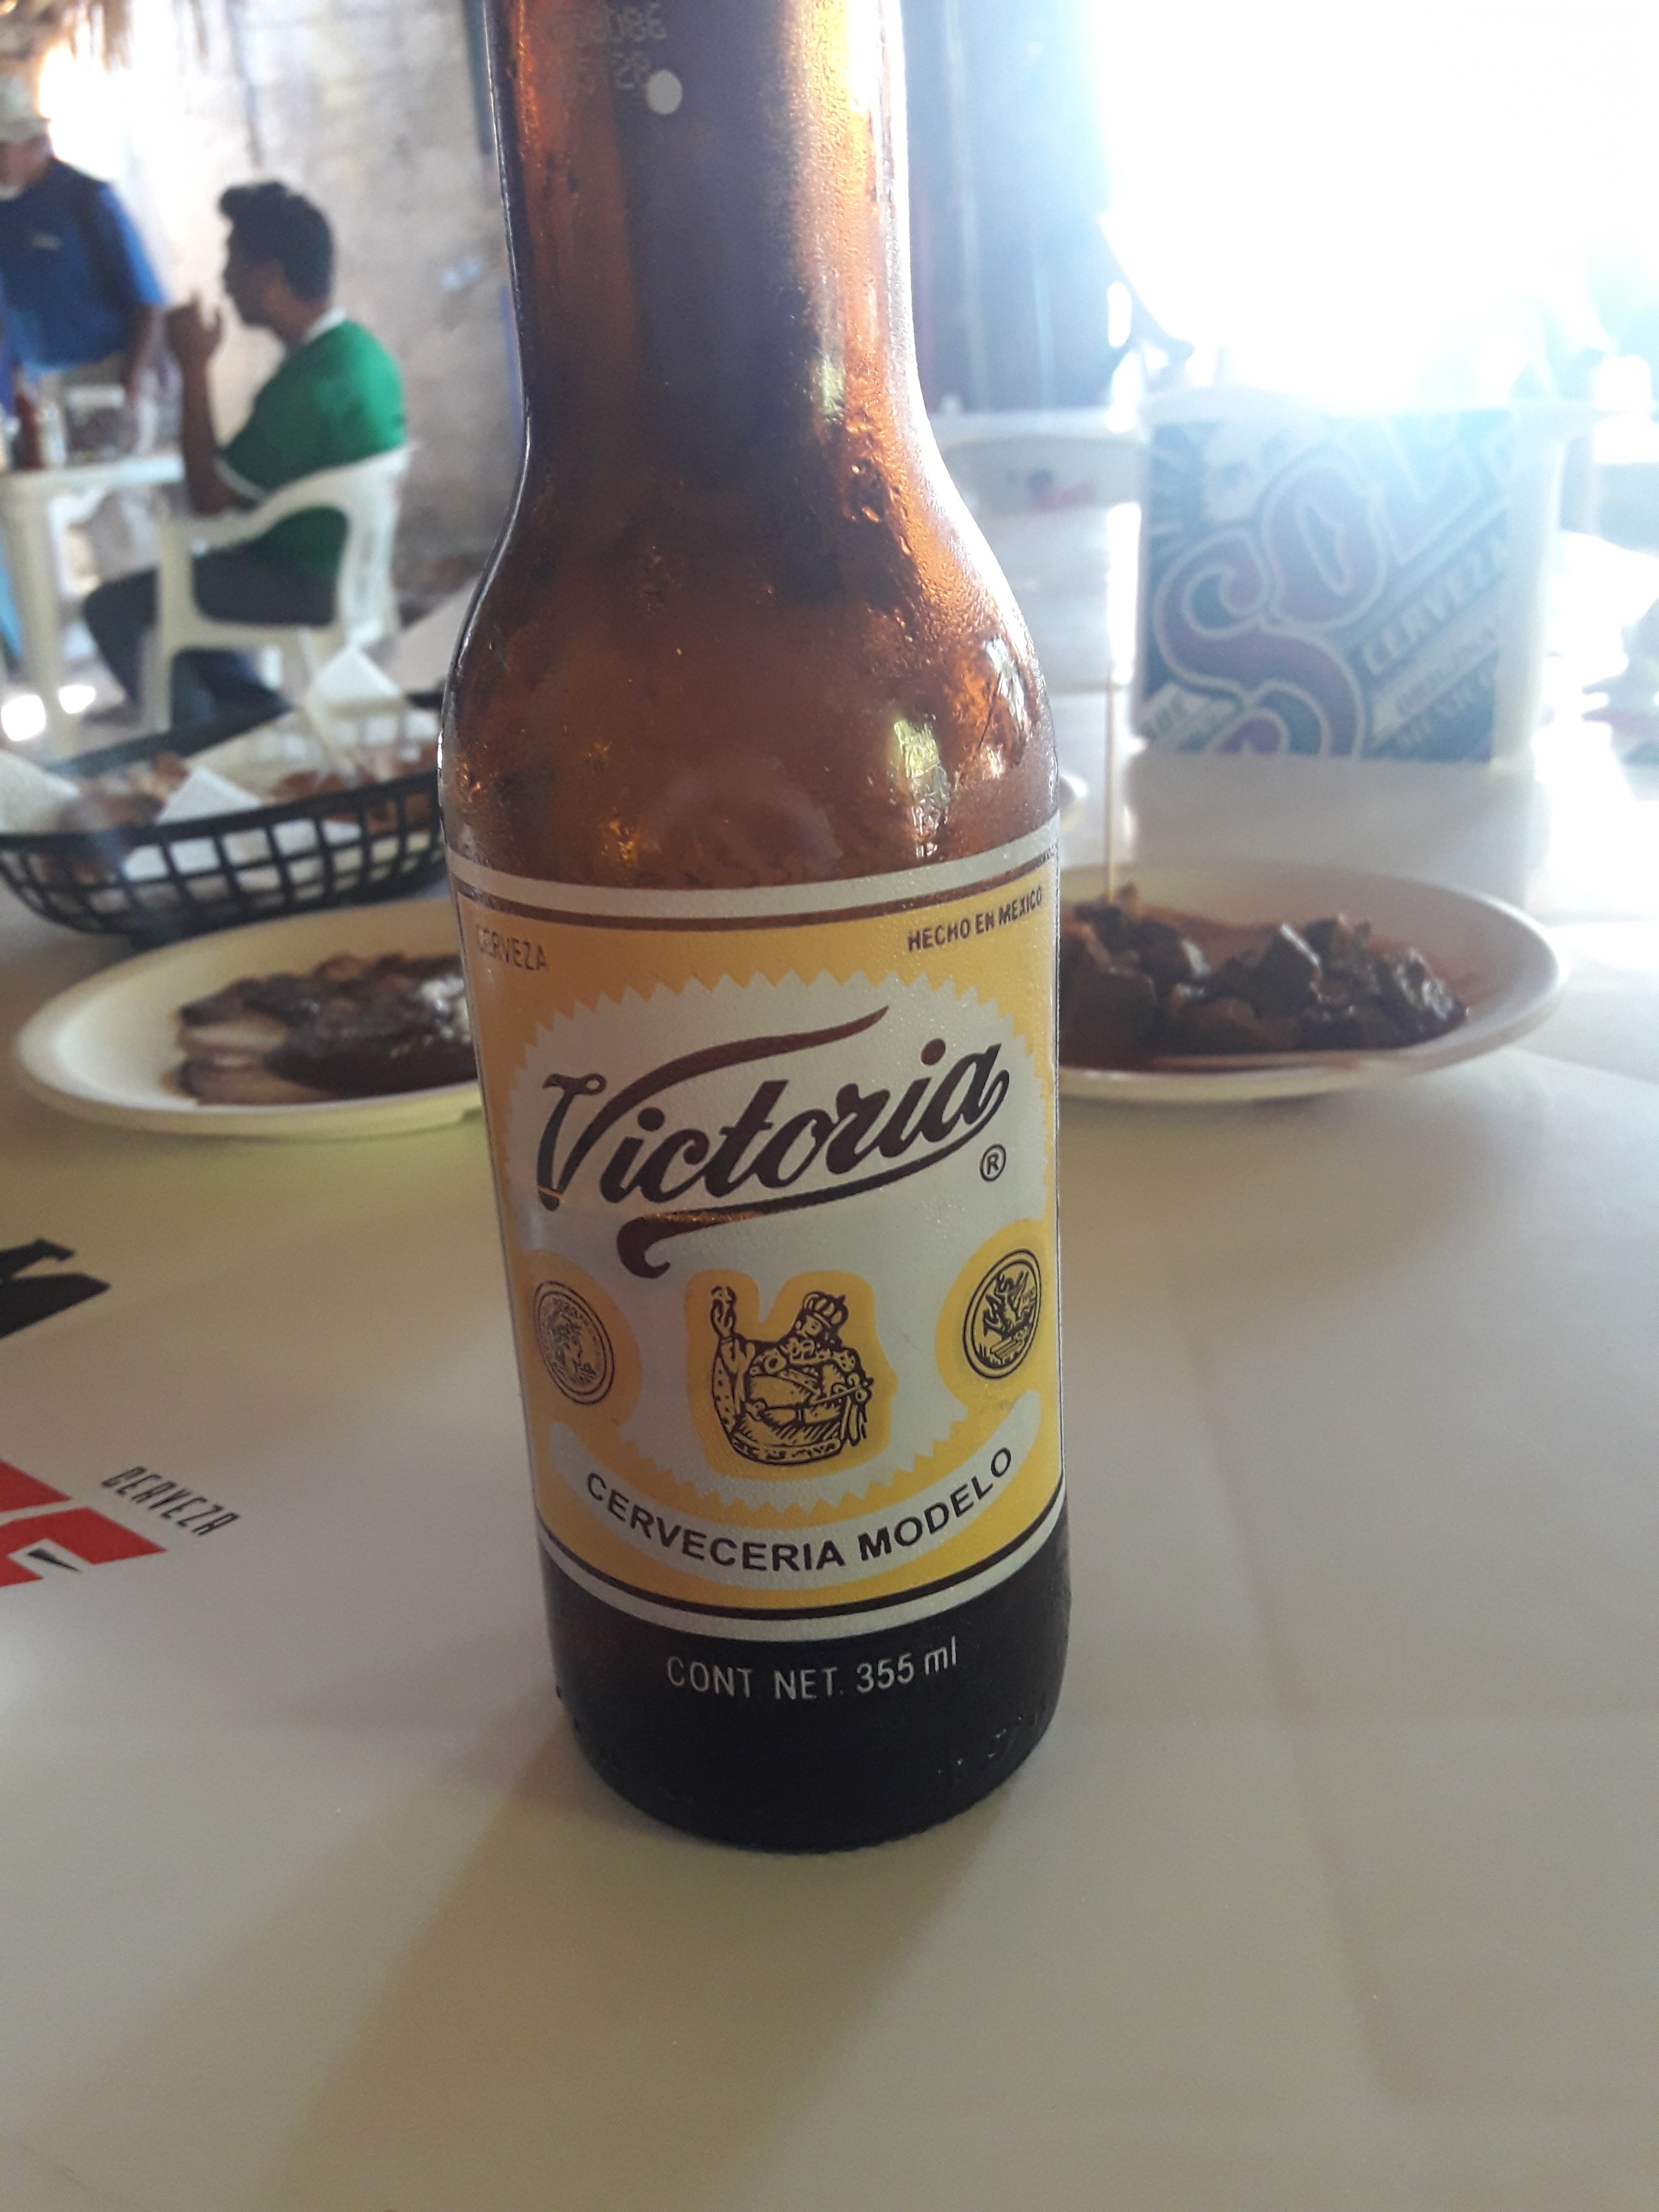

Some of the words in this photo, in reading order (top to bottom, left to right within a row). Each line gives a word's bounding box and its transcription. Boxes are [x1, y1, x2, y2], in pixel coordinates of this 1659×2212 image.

[907, 917, 970, 952] HECHO
[975, 913, 995, 935] EN
[999, 885, 1042, 926] MEXICO
[536, 1005, 1010, 1279] Victoria
[101, 1466, 240, 1536] CERVEZA
[586, 1472, 846, 1571] CERVECERIA
[859, 1447, 1013, 1560] MODELO
[666, 1656, 753, 1698] CONT
[856, 1651, 915, 1694] 355
[924, 1634, 957, 1676] ml
